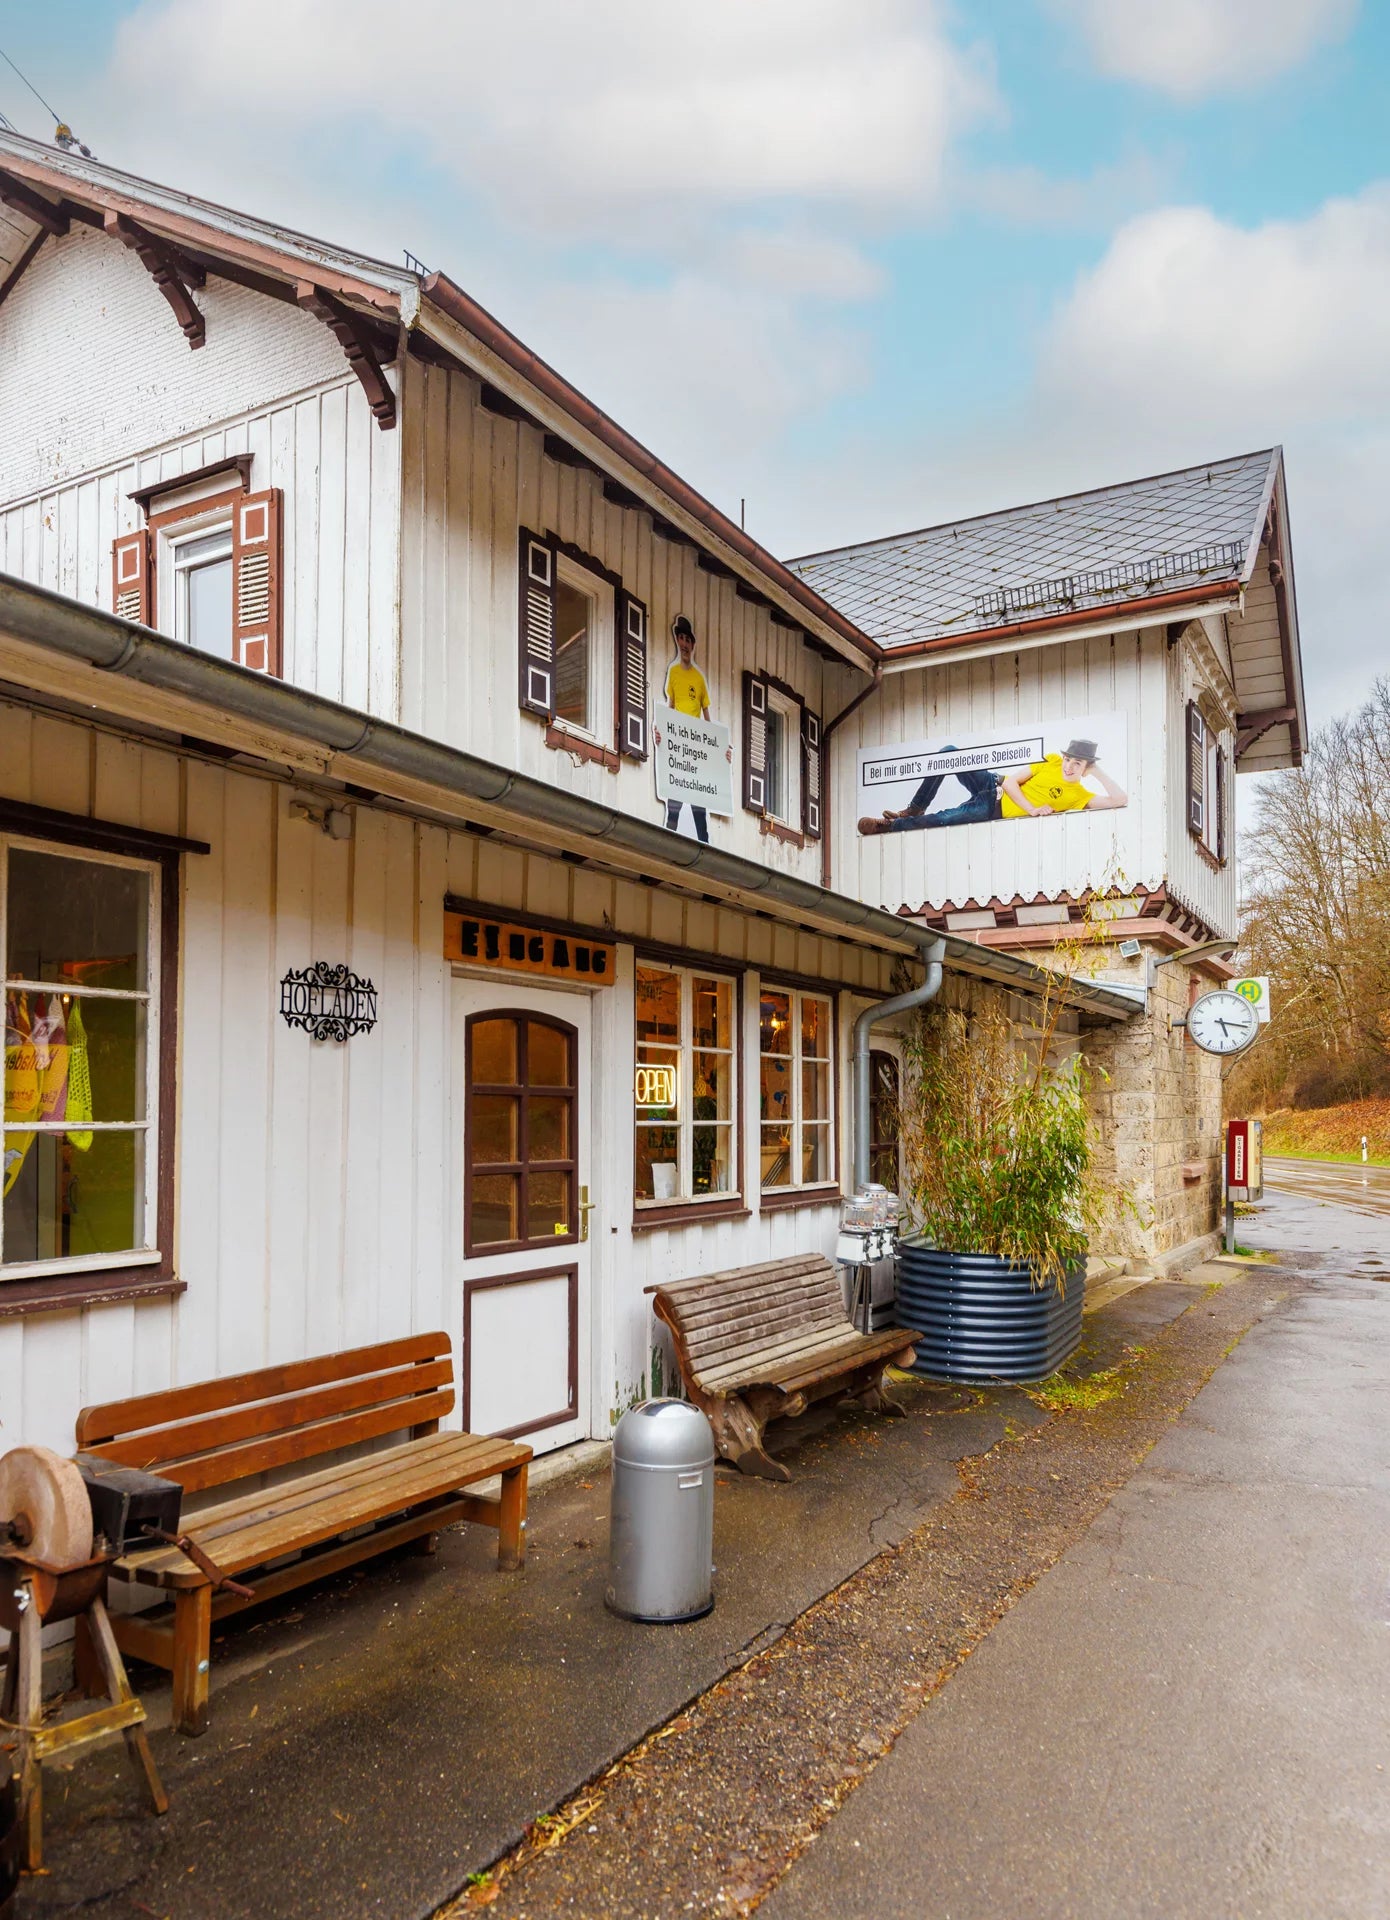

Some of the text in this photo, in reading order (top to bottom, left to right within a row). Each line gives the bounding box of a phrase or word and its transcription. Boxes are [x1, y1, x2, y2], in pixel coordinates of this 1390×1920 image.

[667, 722, 719, 748] Hi, ich bin Paul.
[668, 739, 708, 761] Der jüngste
[668, 754, 698, 774] Ölmüller
[870, 767, 882, 779] Bei
[884, 764, 897, 777] mir
[927, 753, 989, 771] #omegaleckere
[991, 746, 1031, 763] Speiseöle
[669, 773, 718, 795] Deutschlands!
[281, 982, 378, 1022] HOFLADEN
[1241, 985, 1255, 999] H
[635, 1069, 674, 1103] OPEN
